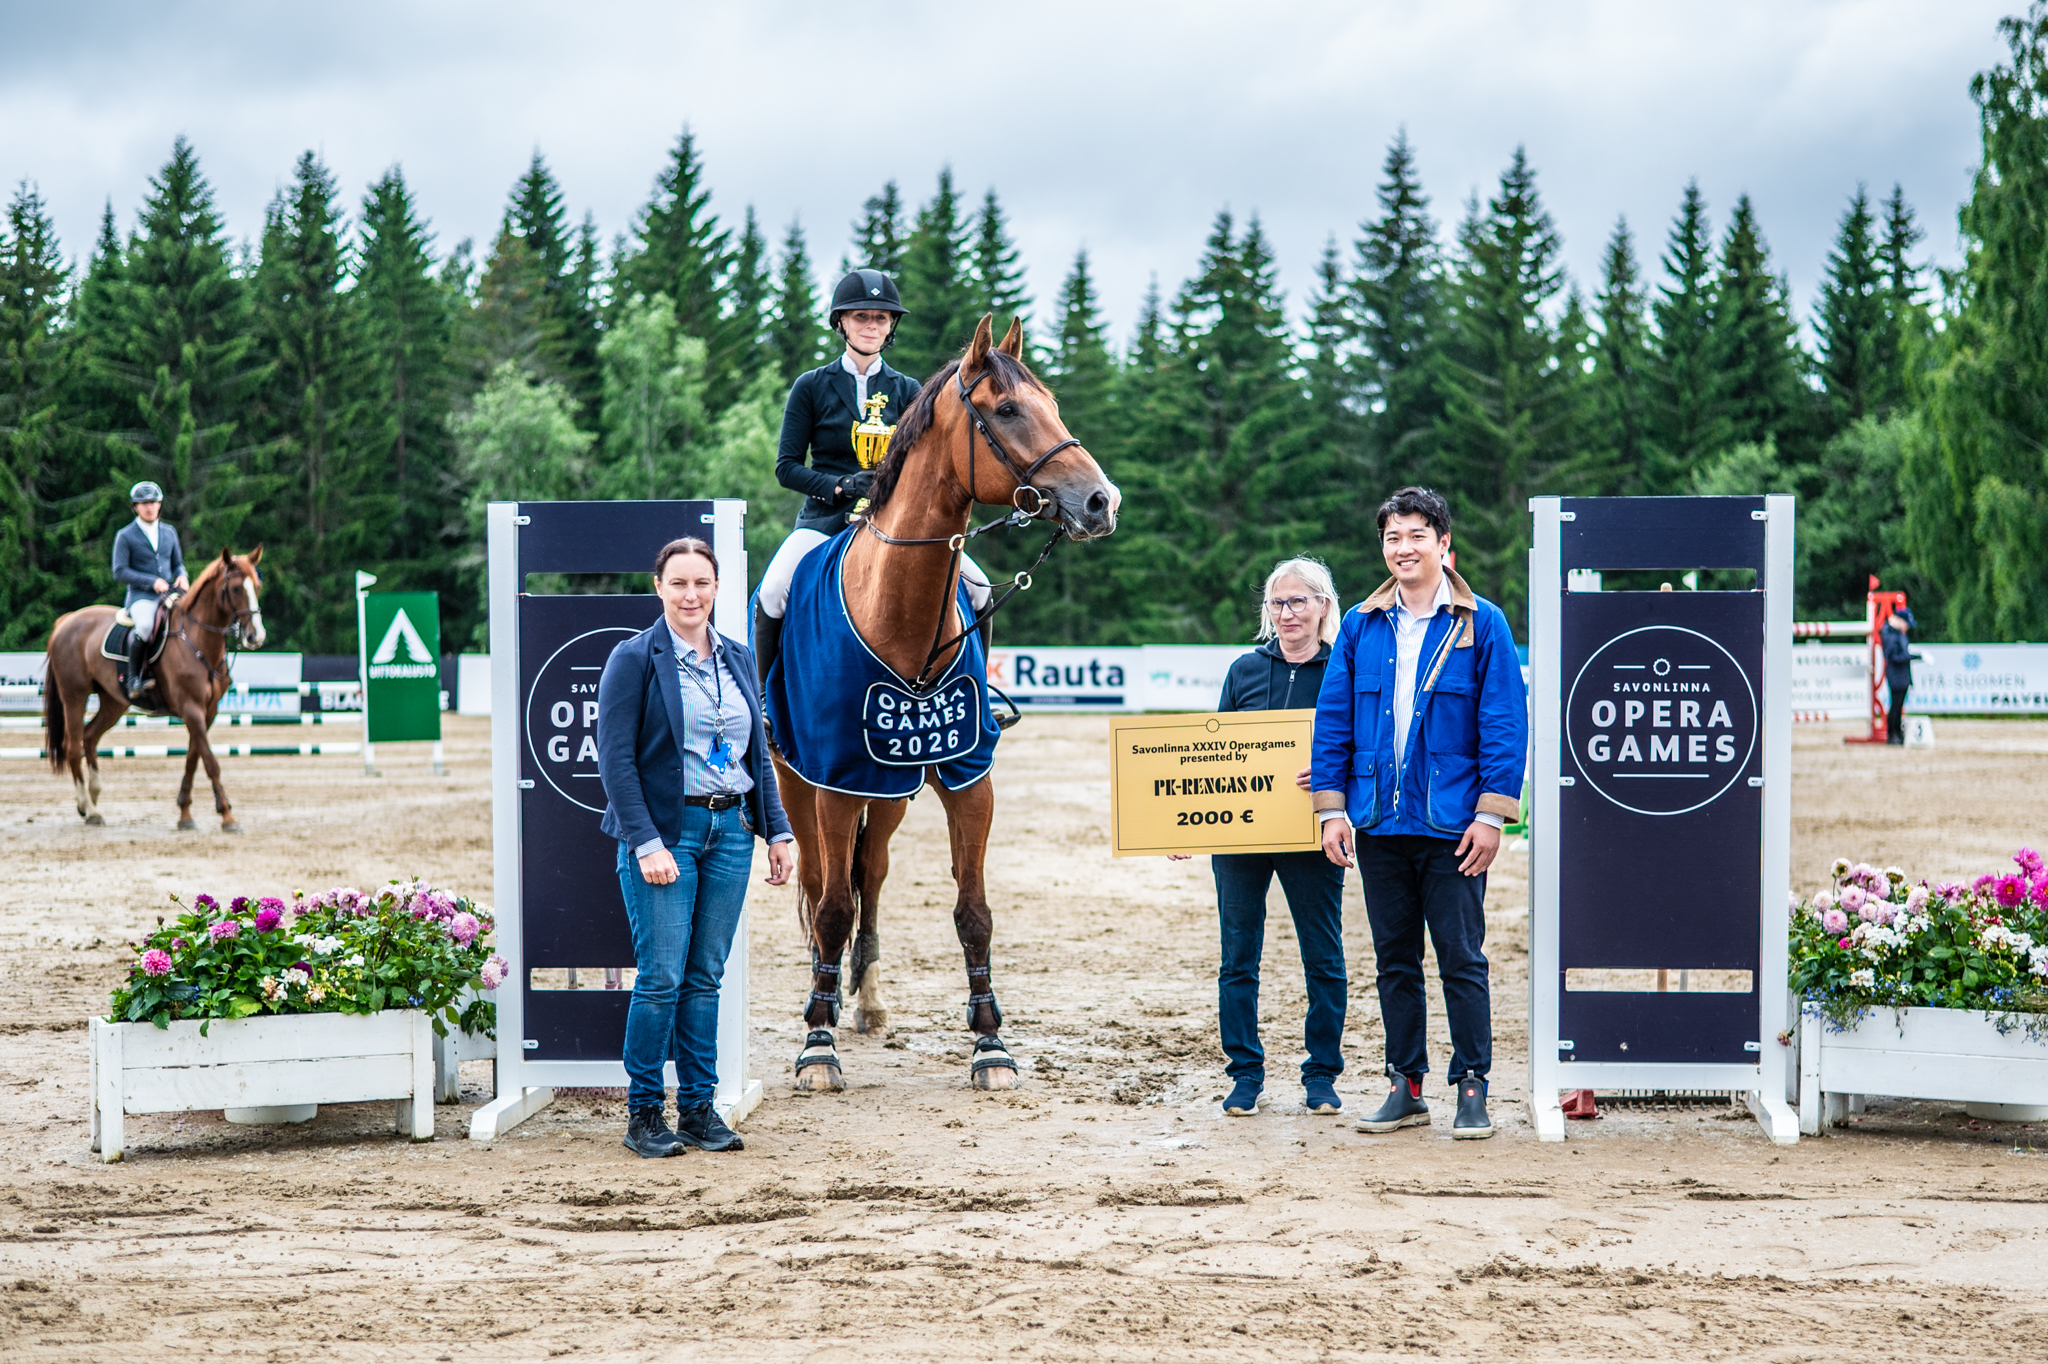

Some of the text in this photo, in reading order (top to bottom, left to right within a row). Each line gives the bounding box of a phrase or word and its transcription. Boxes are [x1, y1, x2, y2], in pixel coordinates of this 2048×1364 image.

[1015, 655, 1124, 686] Rauta
[878, 687, 965, 714] OPERA
[1613, 682, 1711, 693] SAVONLINNA
[876, 702, 966, 731] GAMES
[1591, 699, 1733, 728] OPERA
[888, 729, 959, 756] 2026
[1132, 740, 1296, 754] Savonlinna XXXIV Operagames
[1587, 734, 1736, 763] GAMES
[1180, 751, 1248, 765] presented by
[1154, 775, 1275, 796] PK-RENGAS OY
[1177, 809, 1254, 826] 2000 €
